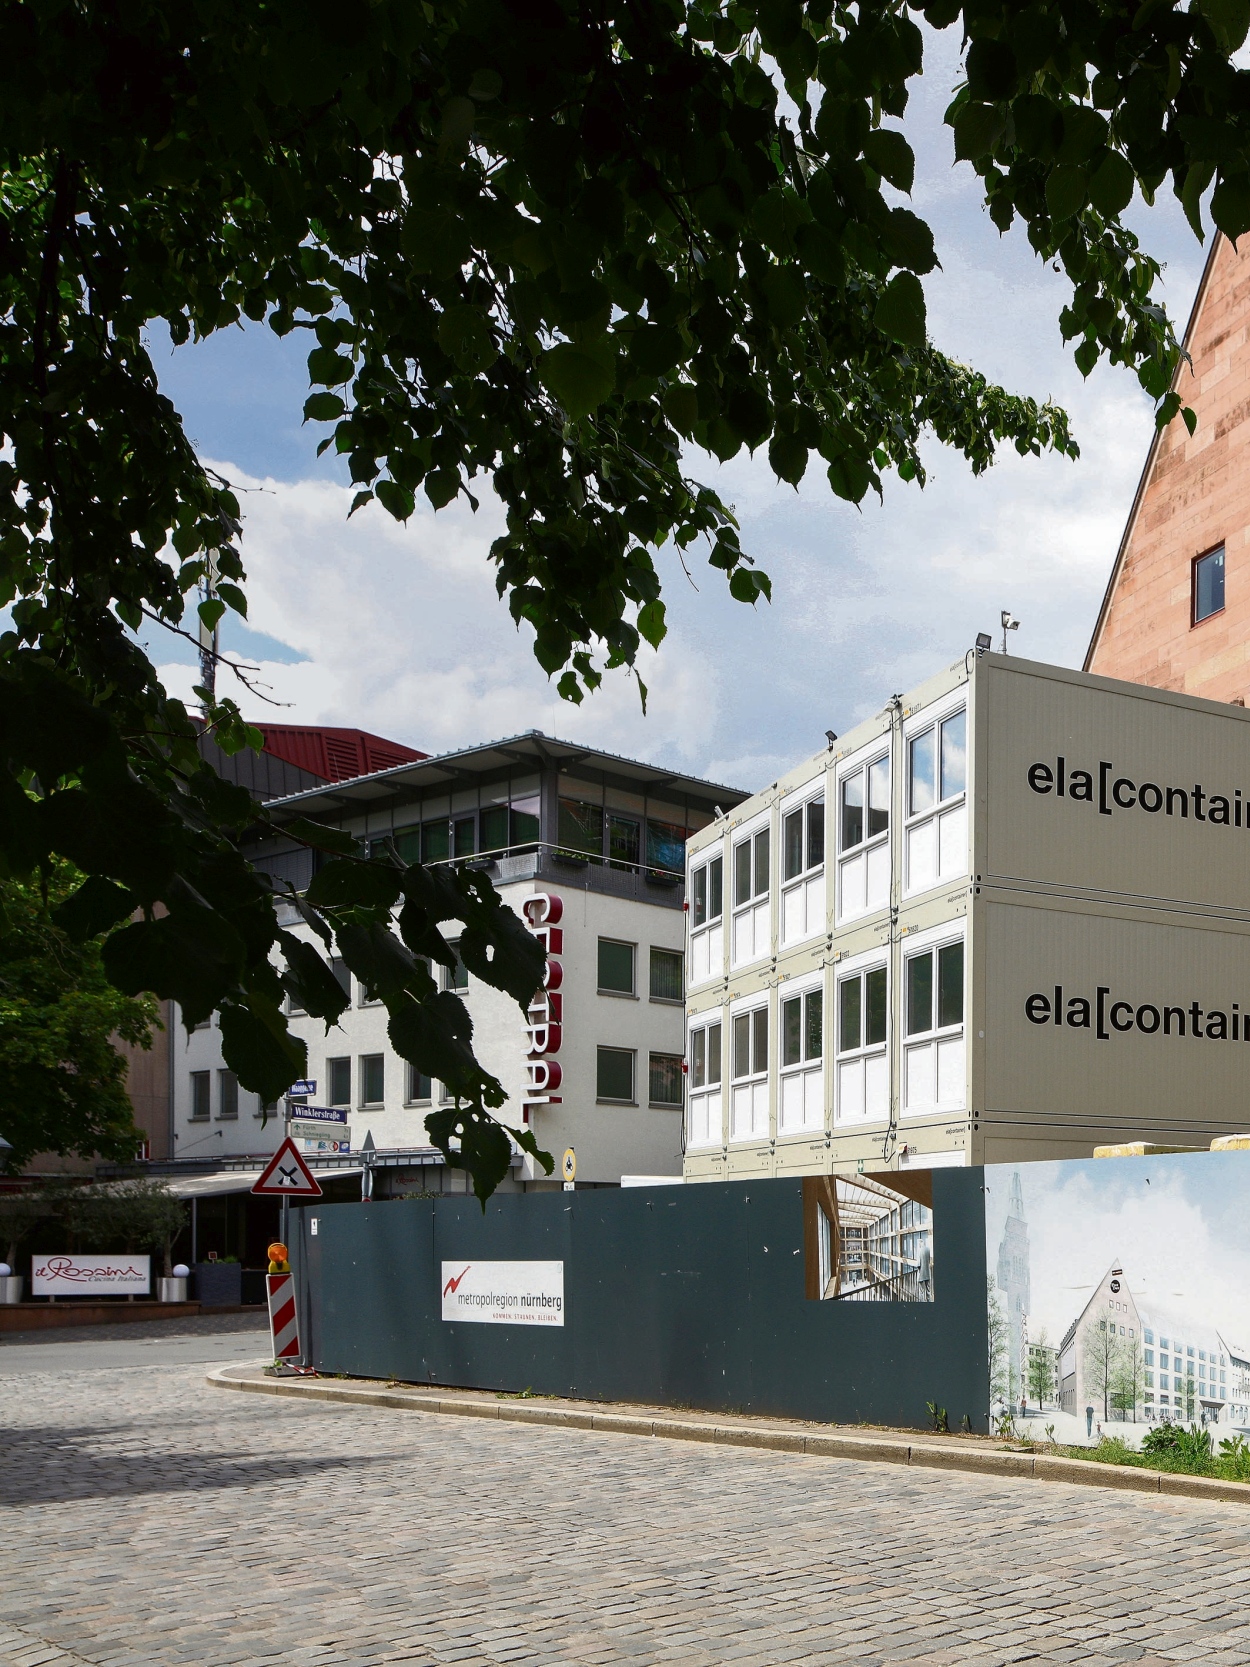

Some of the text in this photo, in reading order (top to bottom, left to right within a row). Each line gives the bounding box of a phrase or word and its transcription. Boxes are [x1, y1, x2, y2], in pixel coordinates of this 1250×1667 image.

[500, 892, 560, 1124] CTRAL
[295, 1106, 340, 1121] Winklerstraße
[46, 1256, 143, 1282] Rossini
[458, 1292, 562, 1312] metropolregion nürnberg
